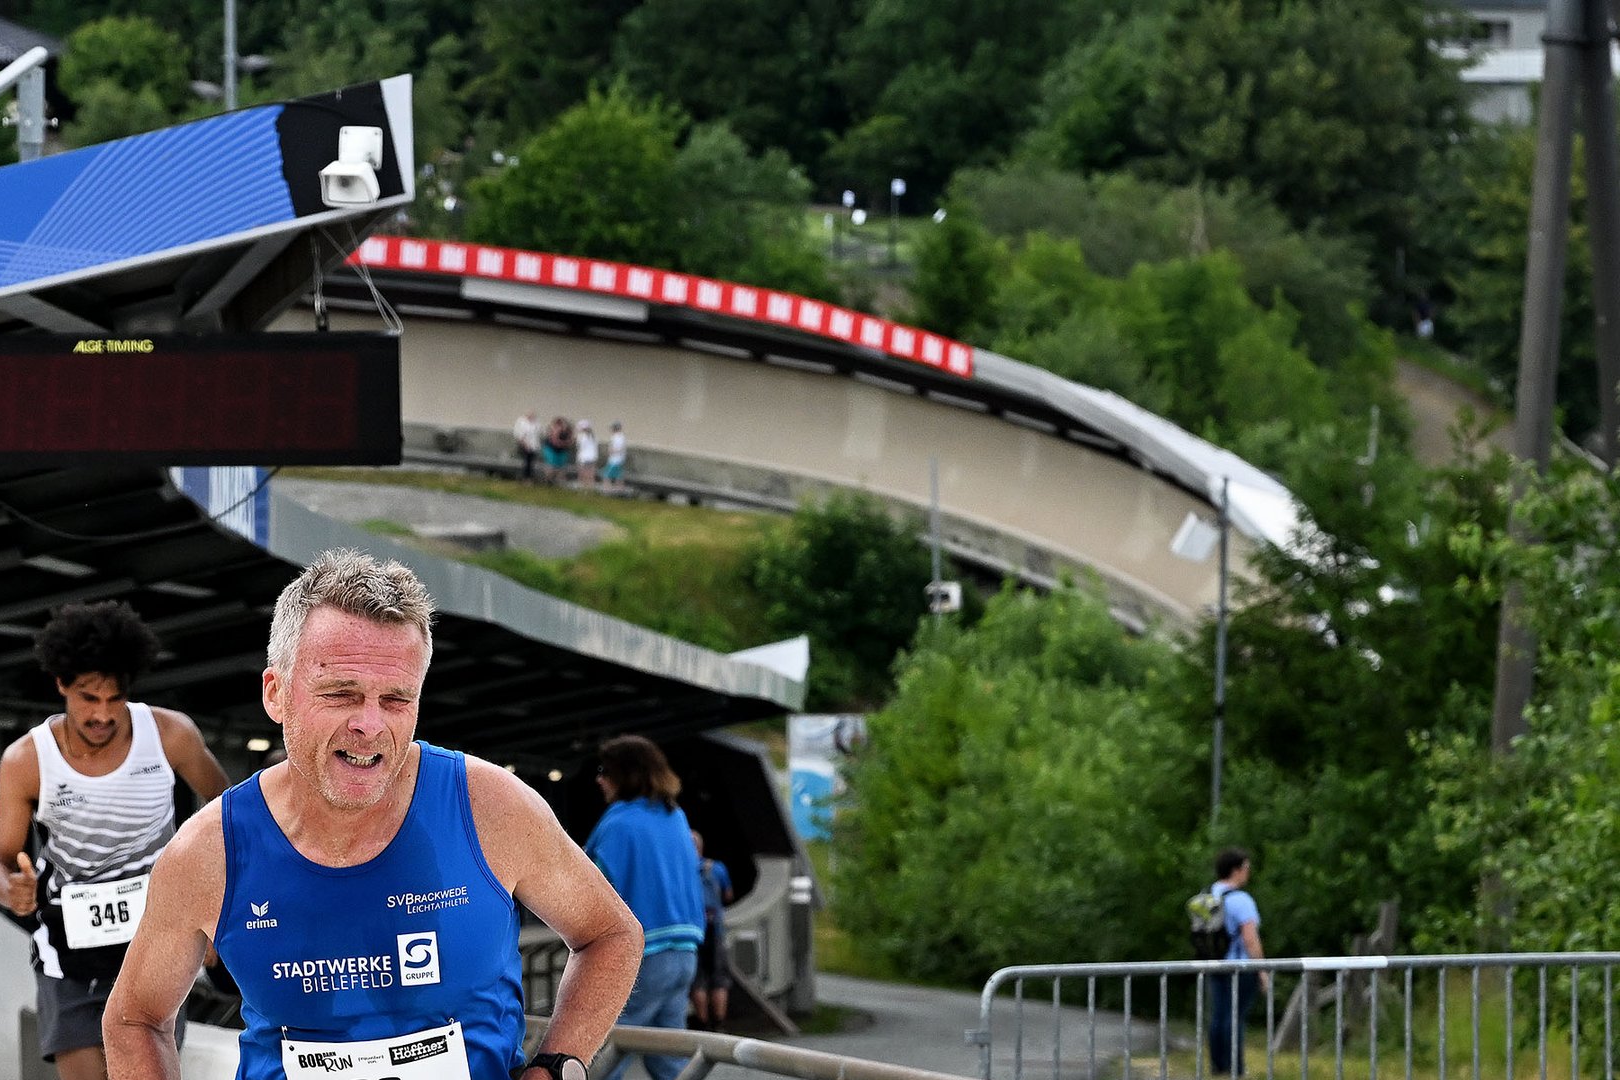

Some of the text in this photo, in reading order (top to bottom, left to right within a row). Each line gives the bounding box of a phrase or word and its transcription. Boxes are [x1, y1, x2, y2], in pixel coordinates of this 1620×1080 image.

[89, 901, 130, 927] 346
[246, 918, 278, 930] erima
[272, 955, 393, 979] STADTWERKE
[405, 970, 435, 981] GRUPPE
[302, 972, 394, 994] BIELEFELD
[391, 1041, 445, 1060] Höffner
